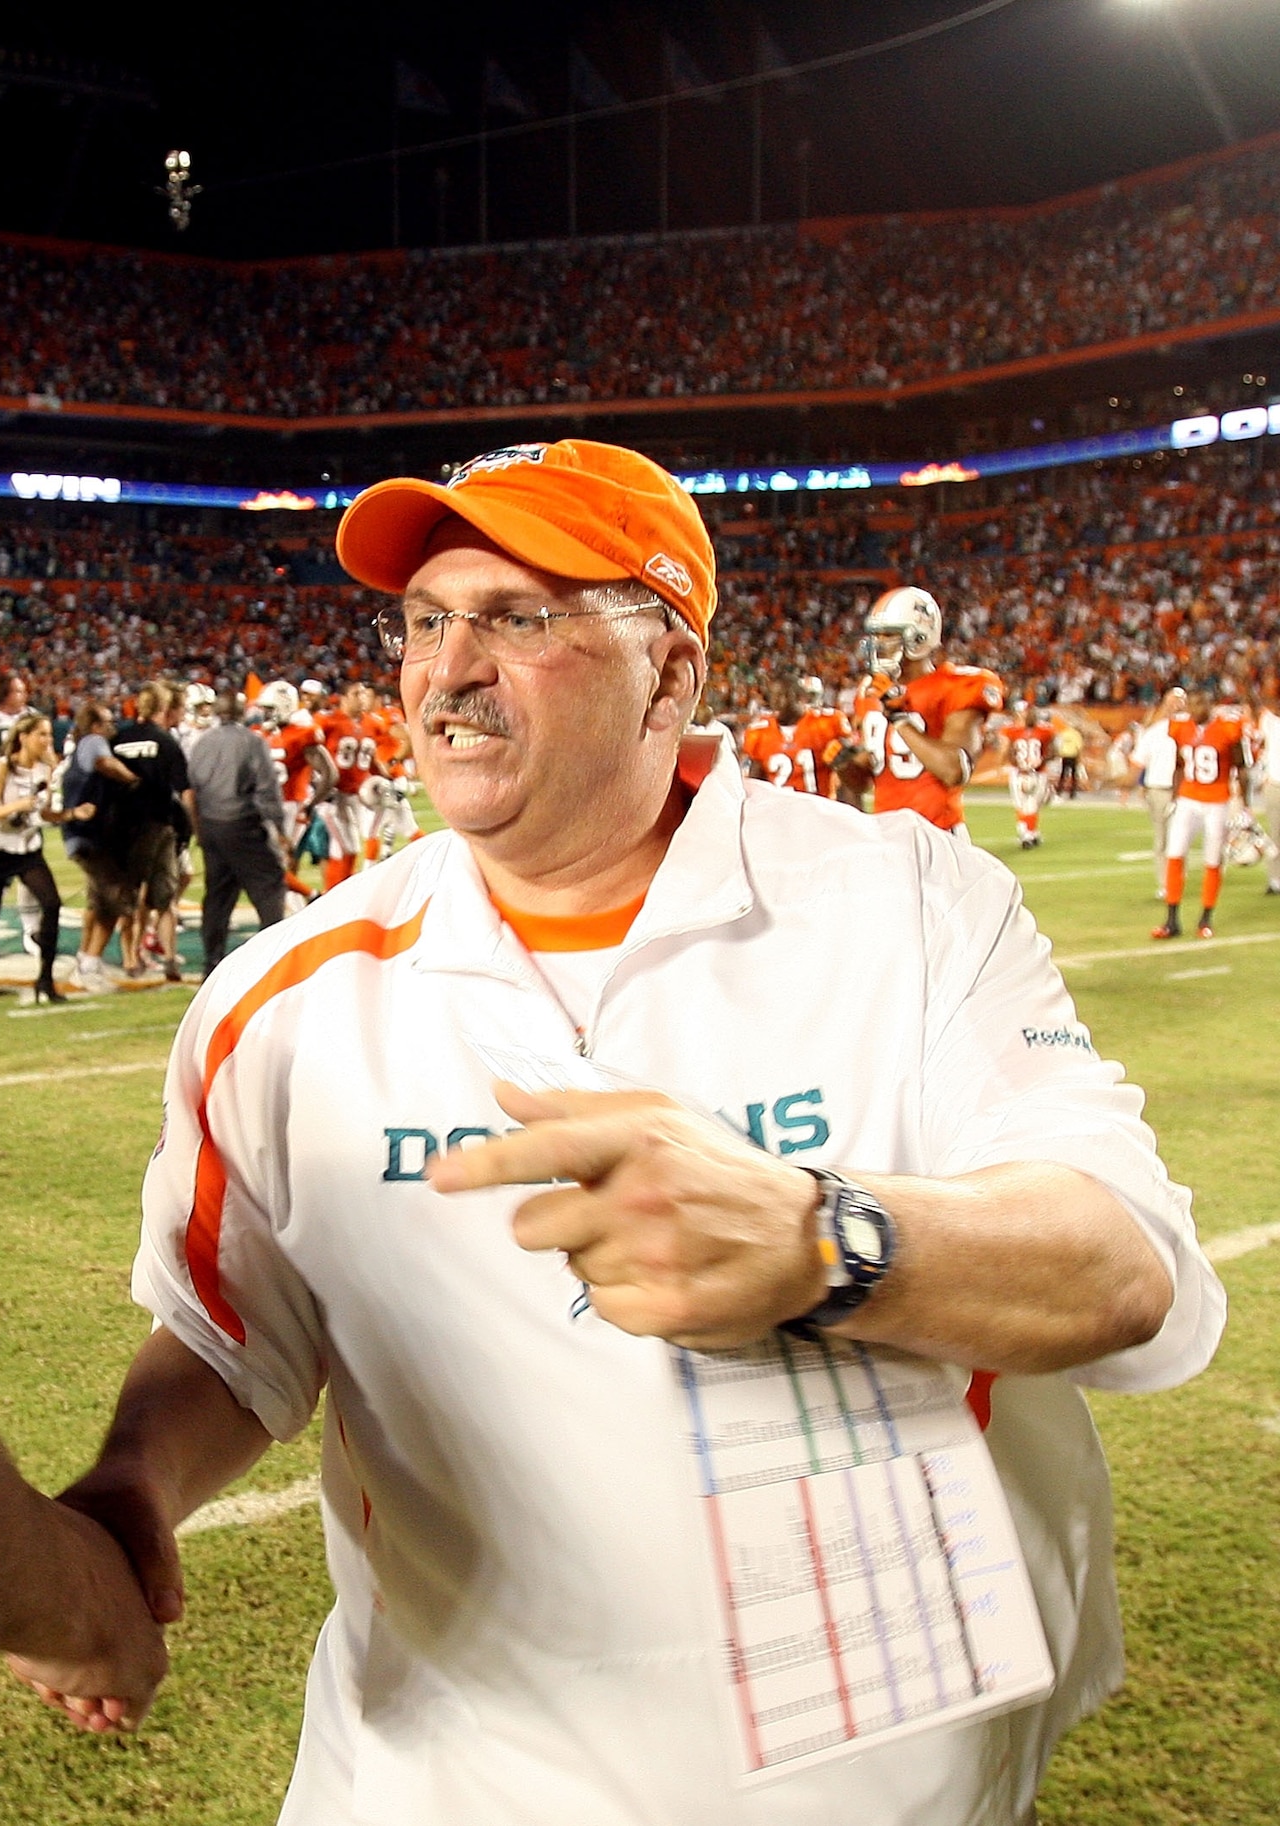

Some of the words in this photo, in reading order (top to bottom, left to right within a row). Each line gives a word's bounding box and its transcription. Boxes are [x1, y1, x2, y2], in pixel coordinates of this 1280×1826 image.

[11, 472, 121, 503] WIN
[768, 748, 817, 793] 21
[1181, 744, 1218, 784] 19
